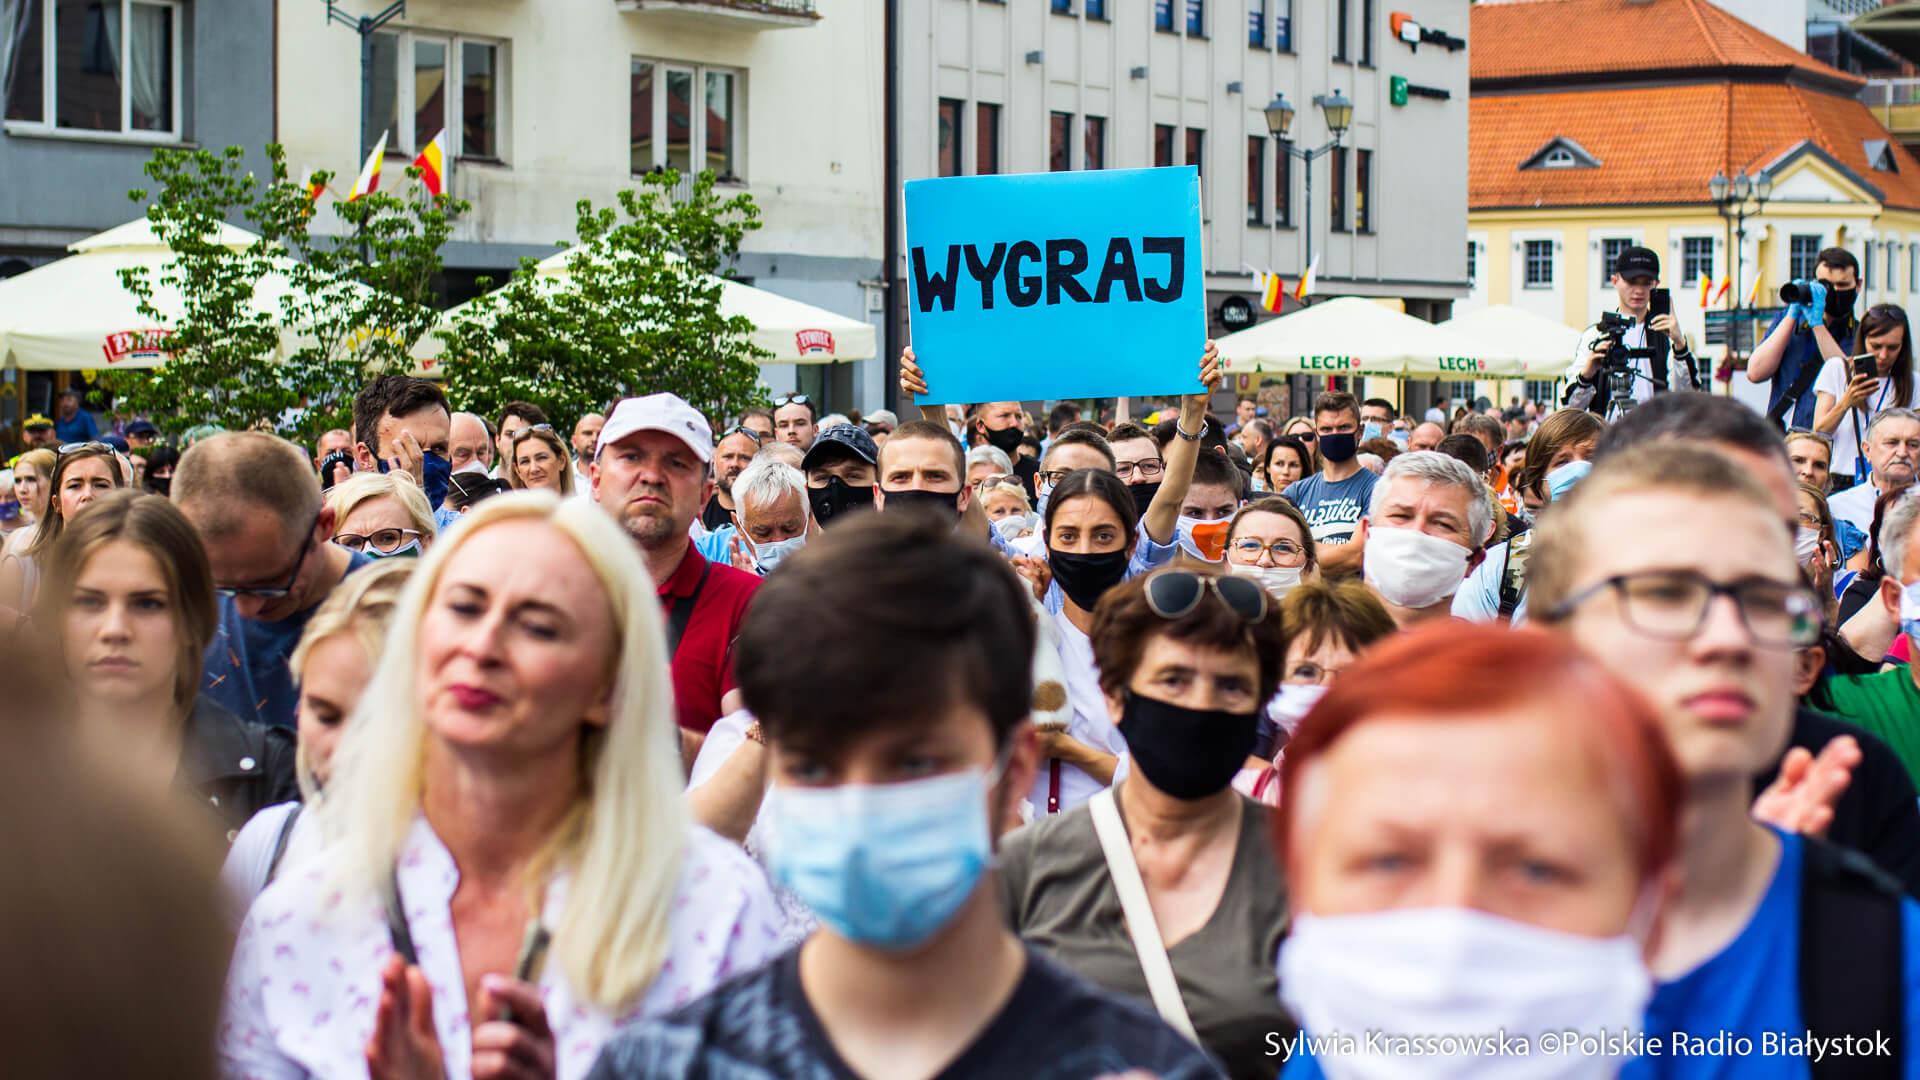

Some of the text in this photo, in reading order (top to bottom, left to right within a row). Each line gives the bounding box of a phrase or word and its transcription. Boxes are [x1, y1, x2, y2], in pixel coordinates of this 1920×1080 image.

[911, 237, 1185, 312] WYGRAJ
[1300, 355, 1350, 369] LECH
[1438, 356, 1477, 371] LECH
